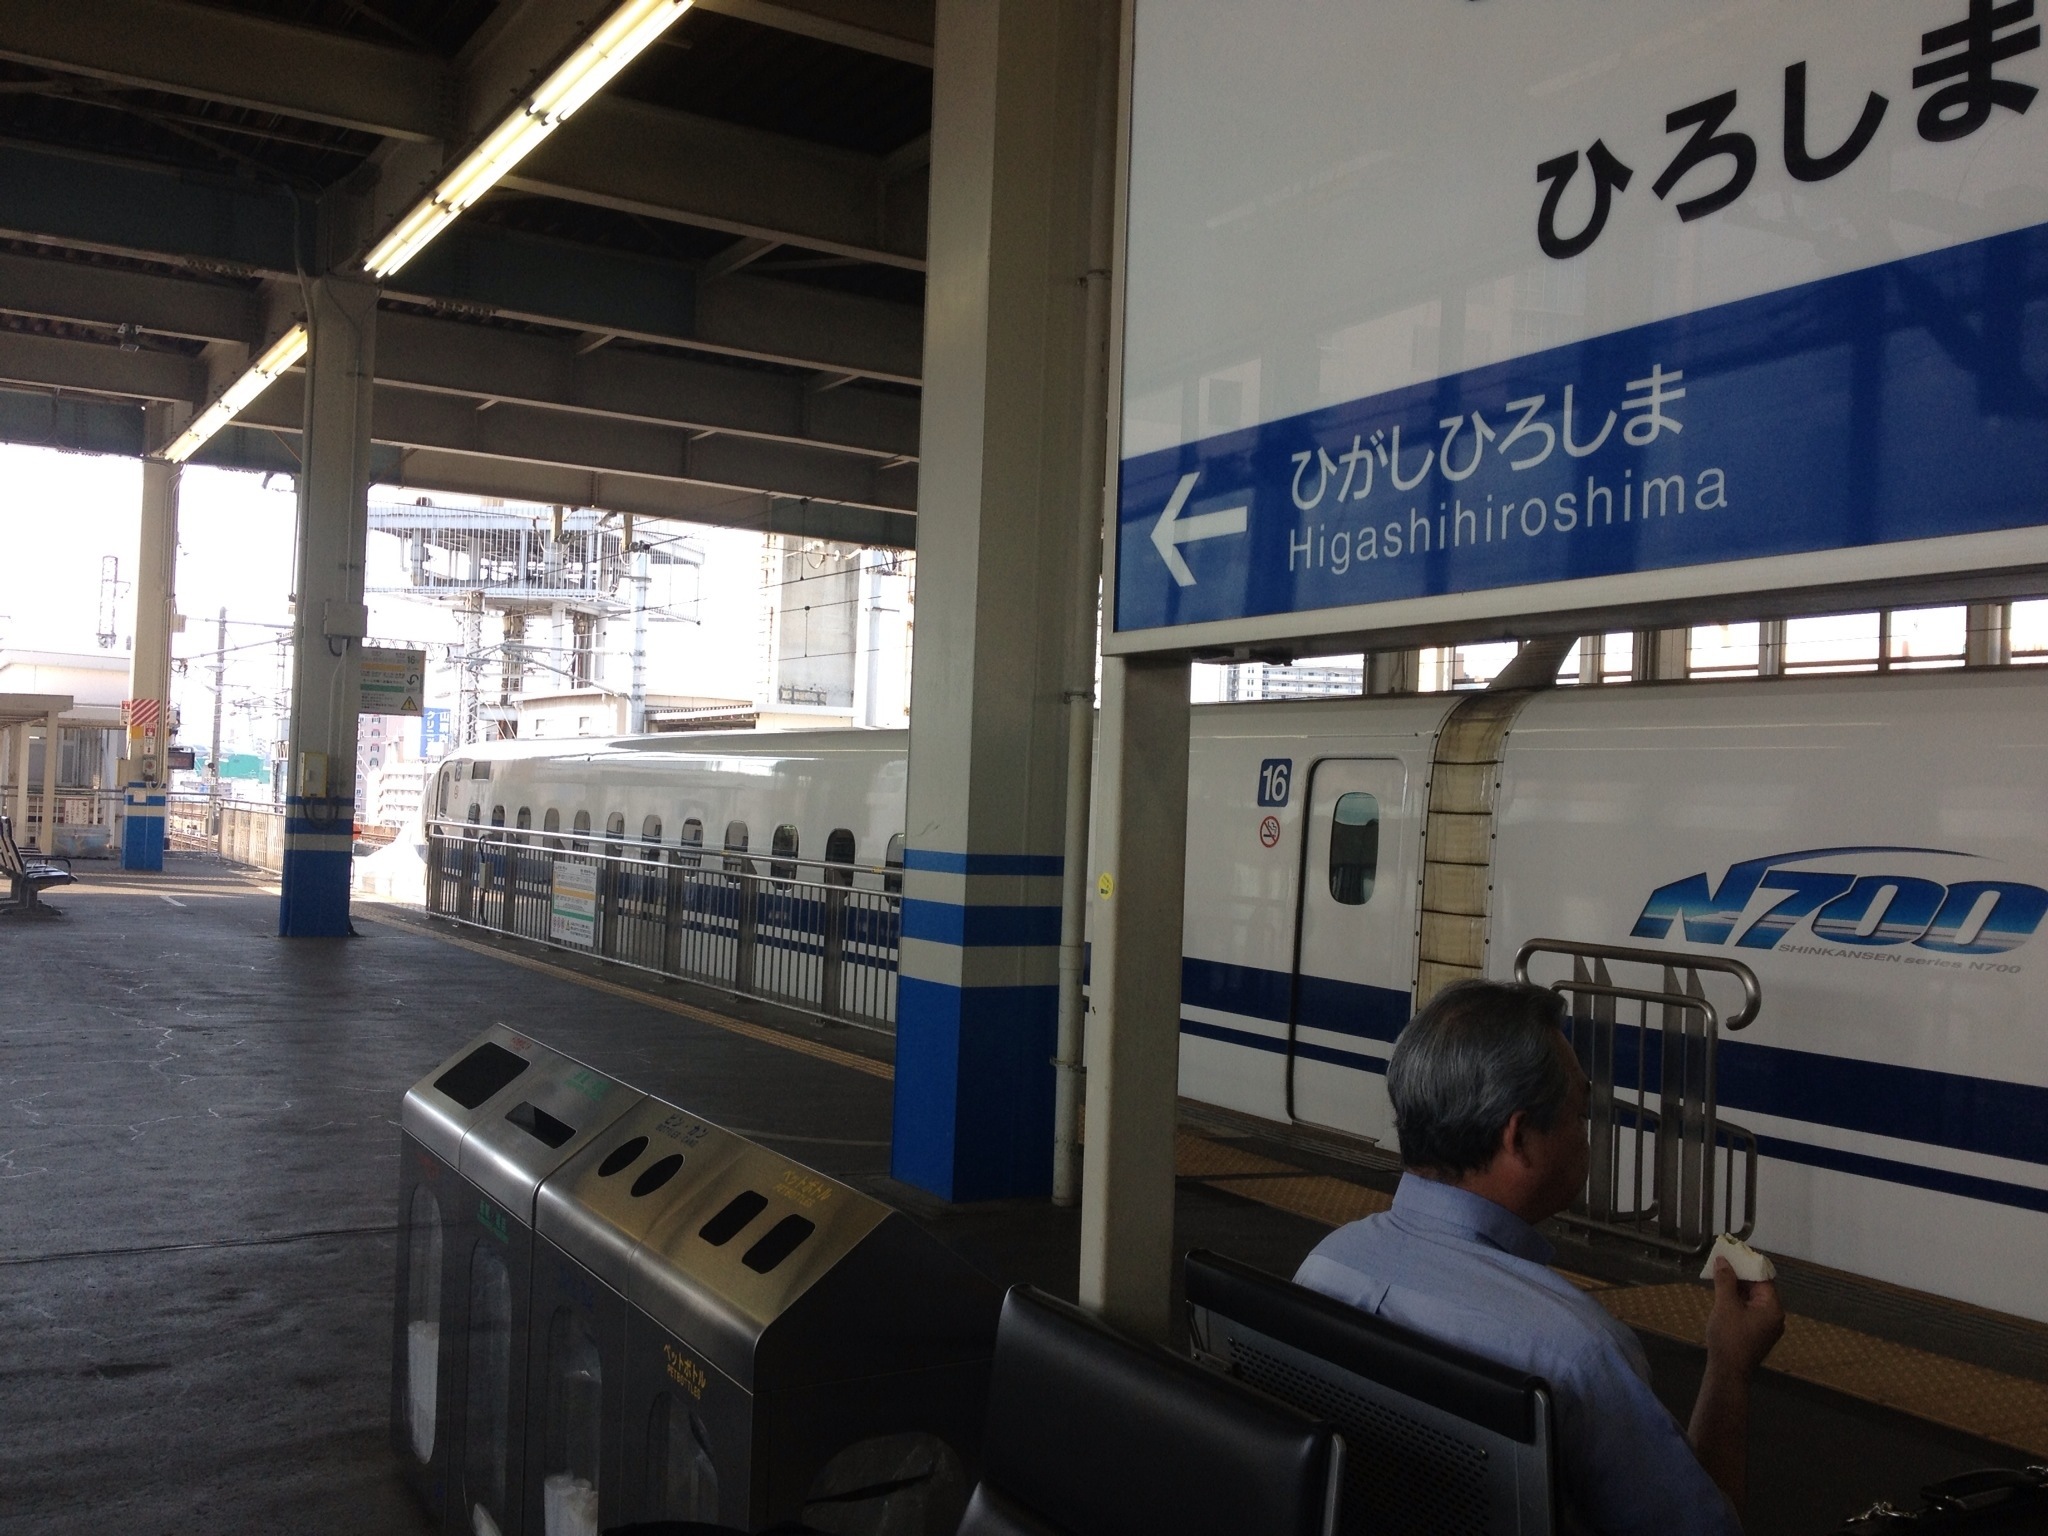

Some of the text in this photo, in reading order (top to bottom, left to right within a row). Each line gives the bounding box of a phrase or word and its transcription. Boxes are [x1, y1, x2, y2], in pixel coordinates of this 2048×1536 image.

[1537, 0, 2040, 260] ひろしま
[1291, 363, 1686, 510] ひがしひろしま
[1289, 467, 1728, 575] Higashihiroshima
[1262, 763, 1288, 802] 16
[1629, 860, 2048, 955] N700
[1777, 943, 2022, 975] SHINKANSEN series N700
[783, 1168, 833, 1201] ペットボトル
[663, 1343, 707, 1388] ペットボトル
